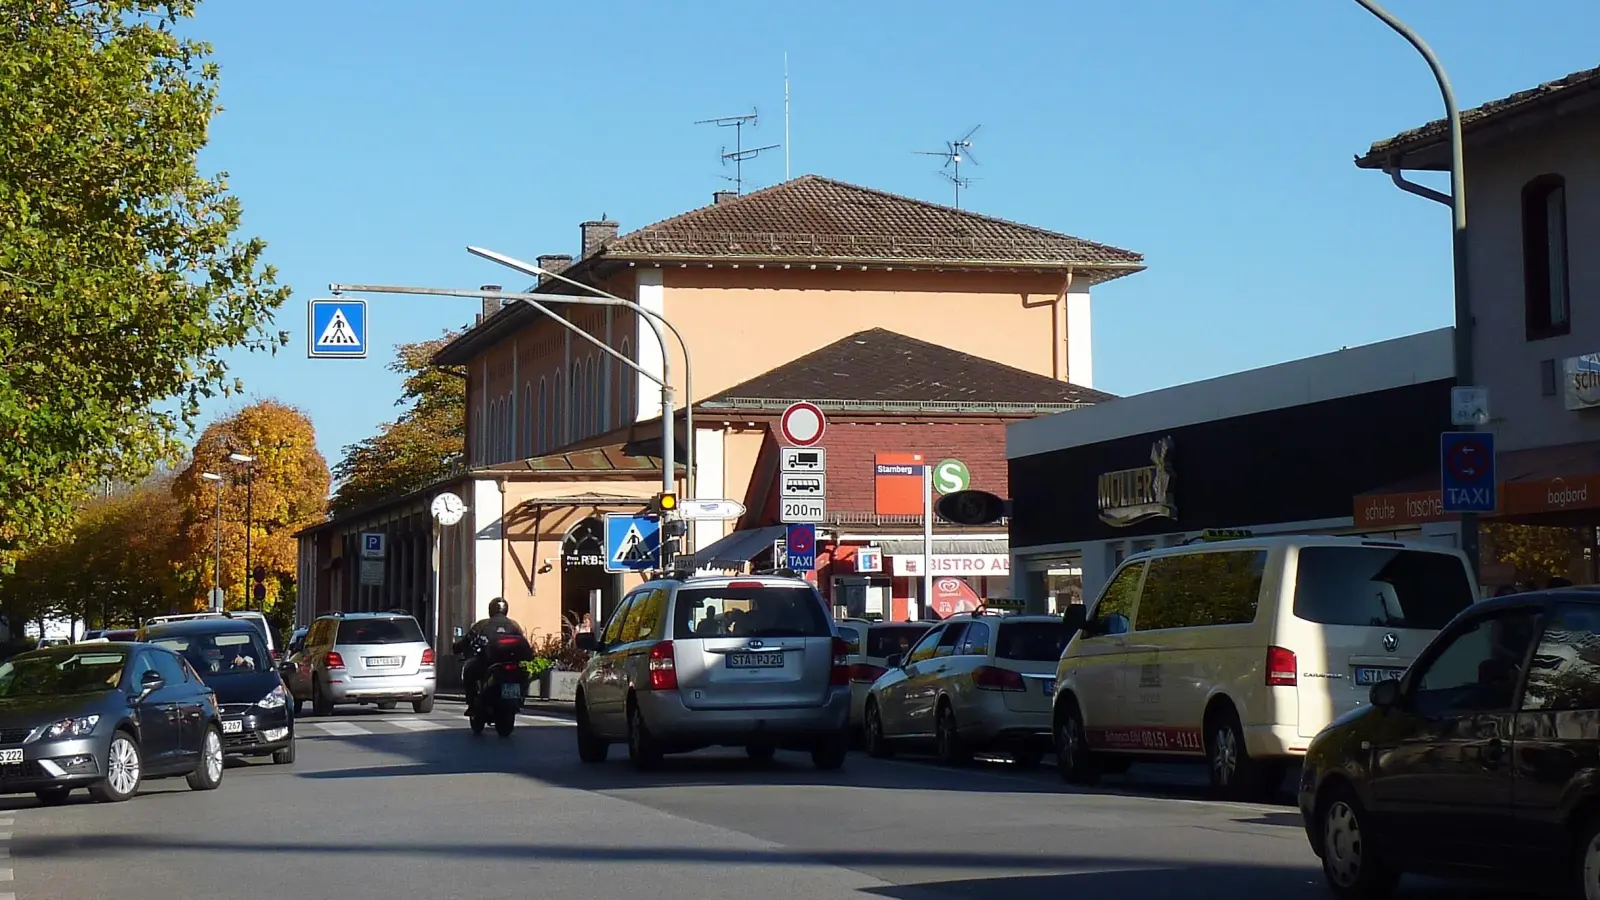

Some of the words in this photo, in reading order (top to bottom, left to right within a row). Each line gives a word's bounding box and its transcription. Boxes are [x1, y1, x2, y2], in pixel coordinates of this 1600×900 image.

[878, 465, 913, 475] Starnberg
[1448, 488, 1489, 505] TAXI
[1547, 484, 1587, 507] bagbord
[785, 504, 808, 516] 200
[810, 507, 822, 516] m
[1365, 499, 1395, 520] schuhe
[368, 537, 378, 548] P
[790, 556, 813, 567] TAXI
[733, 655, 751, 665] STA
[1363, 669, 1384, 681] STA
[1141, 731, 1168, 747] 08151
[1176, 731, 1200, 748] 4111
